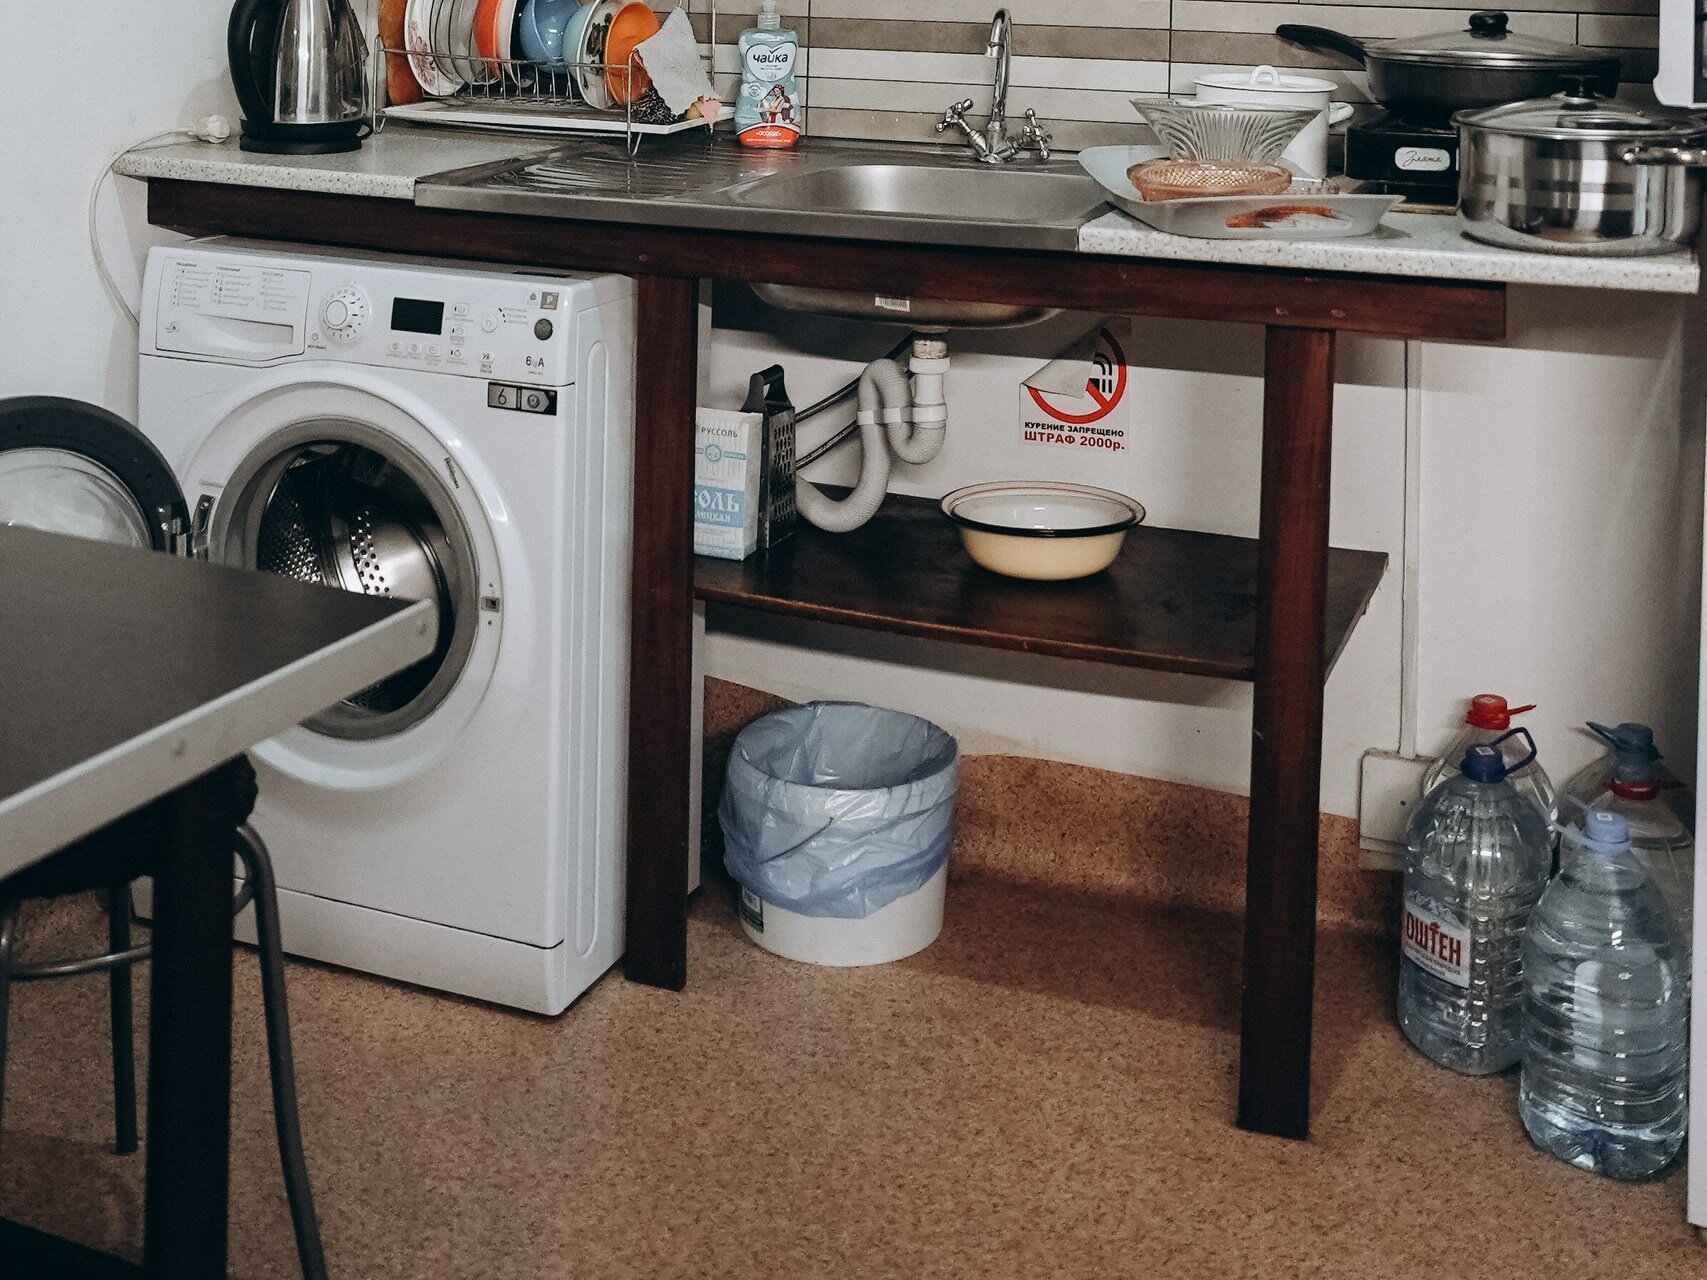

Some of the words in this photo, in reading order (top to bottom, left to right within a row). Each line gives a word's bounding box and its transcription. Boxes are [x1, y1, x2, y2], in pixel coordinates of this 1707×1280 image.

[498, 388, 507, 406] 6
[701, 426, 739, 438] РУССОЛЬ
[1024, 422, 1065, 432] КУРЕНИЕ
[1067, 425, 1124, 437] ЗАПРЕЩЕНО
[1024, 431, 1076, 444] ШТРАФ
[1079, 435, 1125, 451] 2000р.
[695, 489, 740, 513] ОЛЬ
[1406, 911, 1462, 967] ОШТЕН
